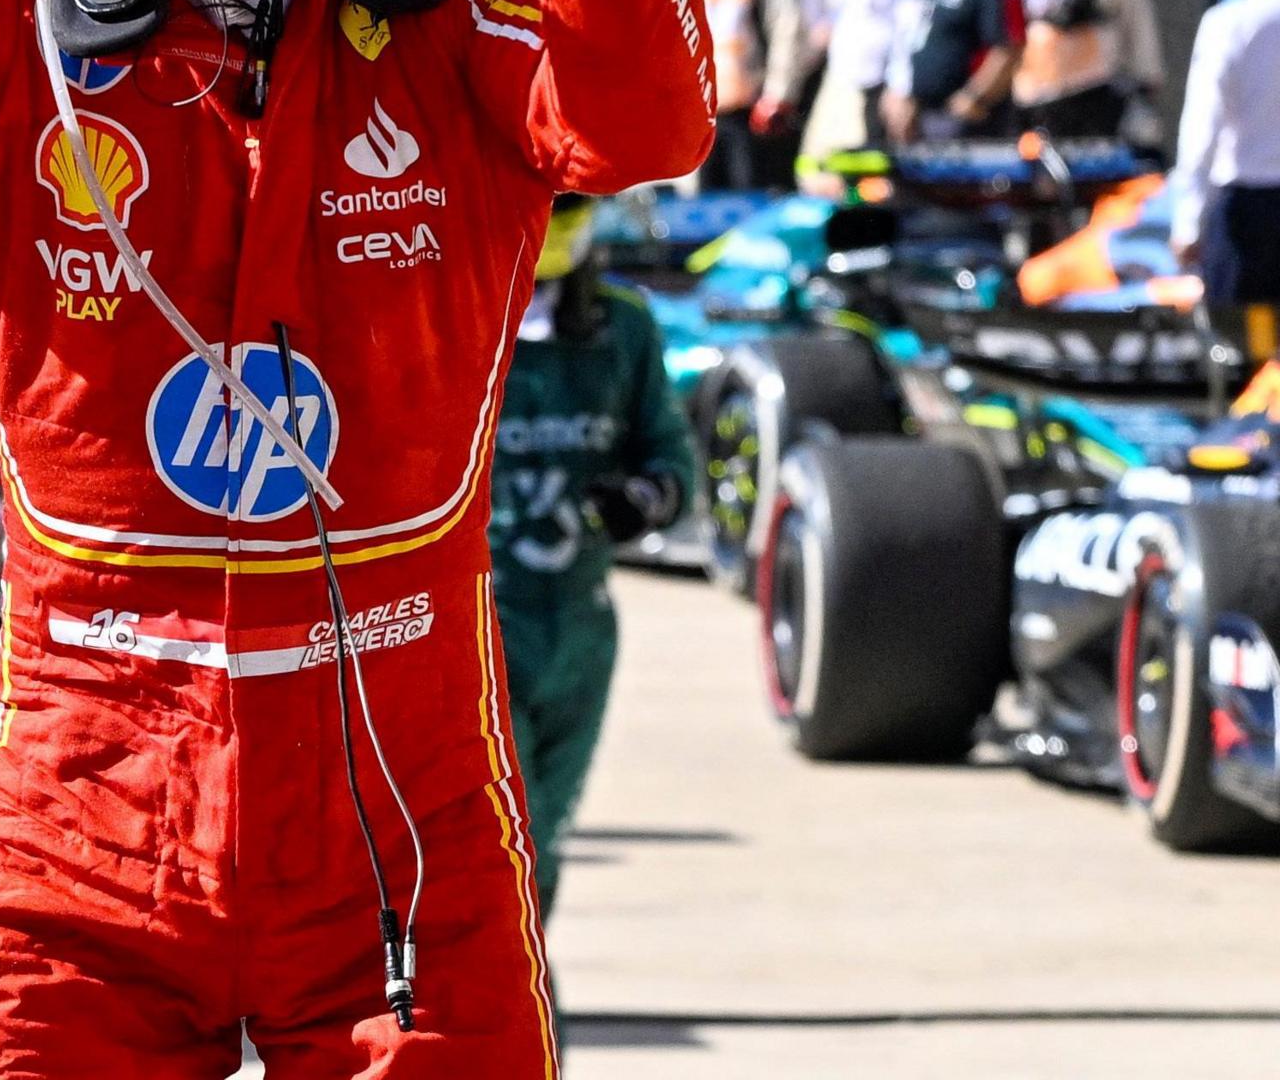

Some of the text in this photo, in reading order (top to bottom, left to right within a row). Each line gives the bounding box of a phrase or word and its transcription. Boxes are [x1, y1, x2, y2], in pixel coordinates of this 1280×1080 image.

[320, 180, 446, 217] Santander
[34, 238, 153, 294] VGW
[55, 288, 122, 321] PLAY
[83, 608, 140, 652] 16
[308, 591, 430, 643] CHARLES
